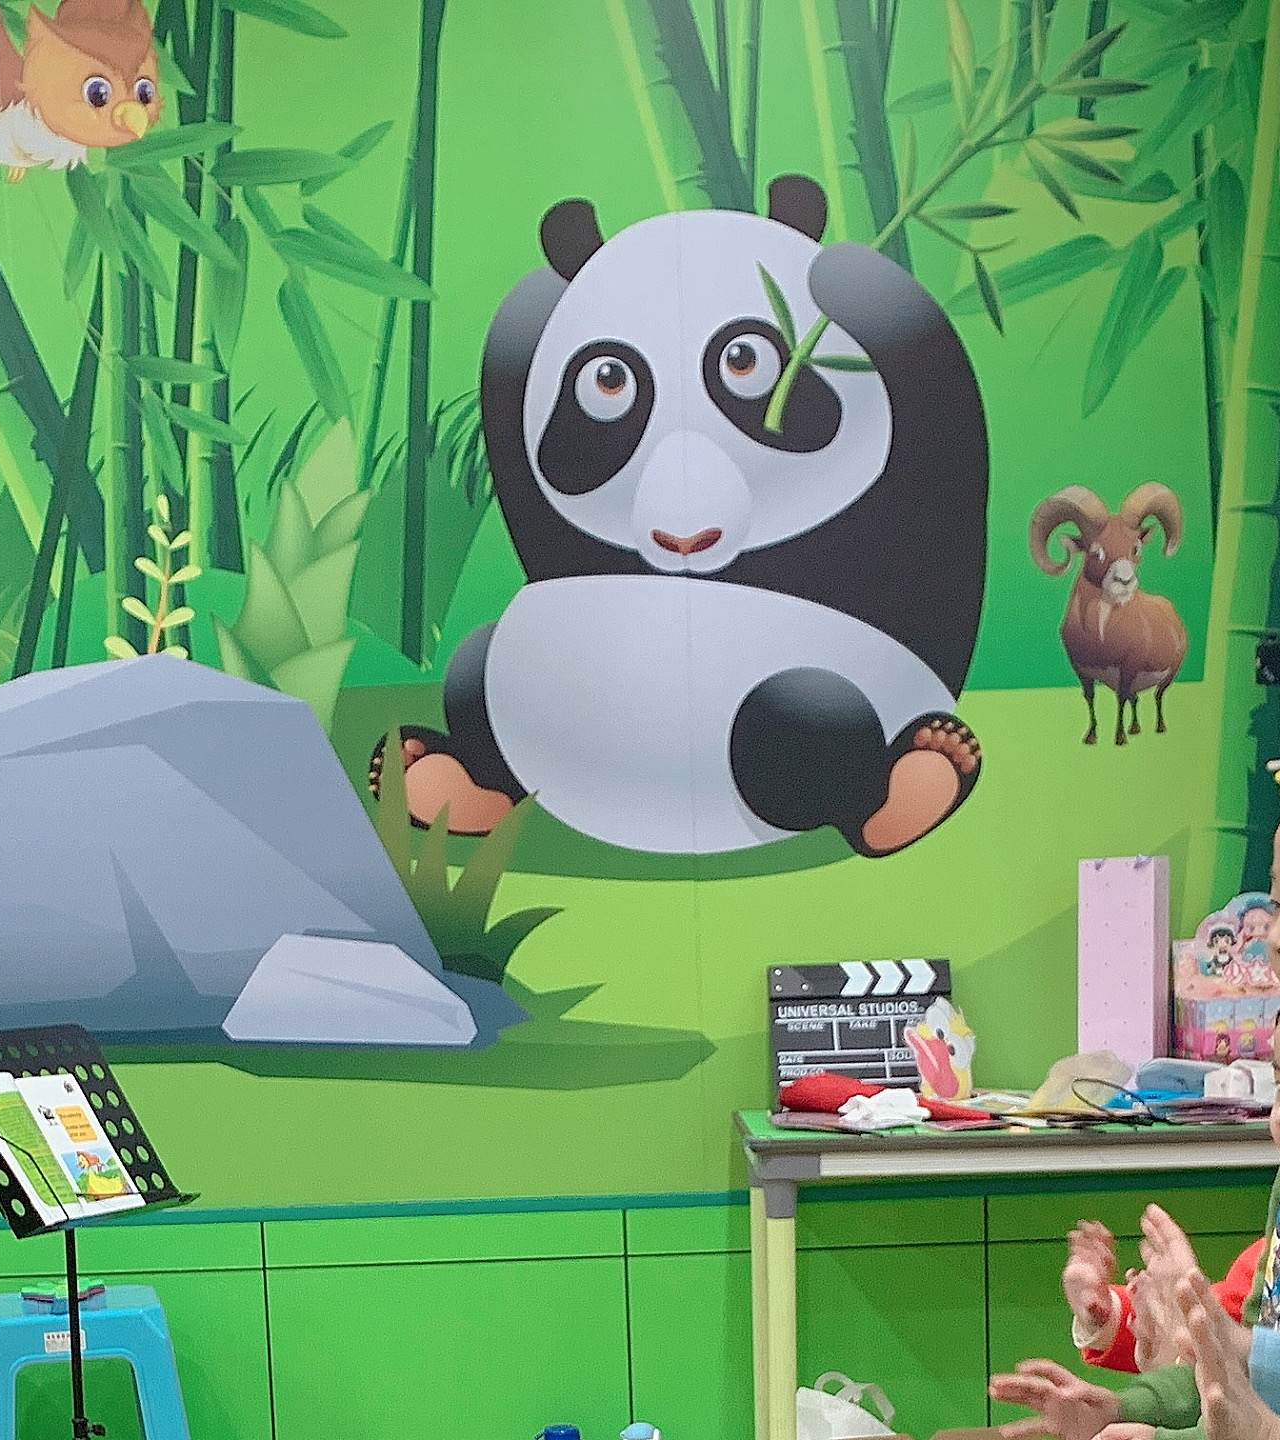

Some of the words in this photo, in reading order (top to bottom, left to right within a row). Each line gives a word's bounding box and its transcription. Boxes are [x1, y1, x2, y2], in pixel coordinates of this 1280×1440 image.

[778, 1003, 855, 1018] UNIVERSAL
[859, 1001, 918, 1015] STUDIOS
[787, 1021, 824, 1032] SCENE
[849, 1019, 877, 1029] TAKE
